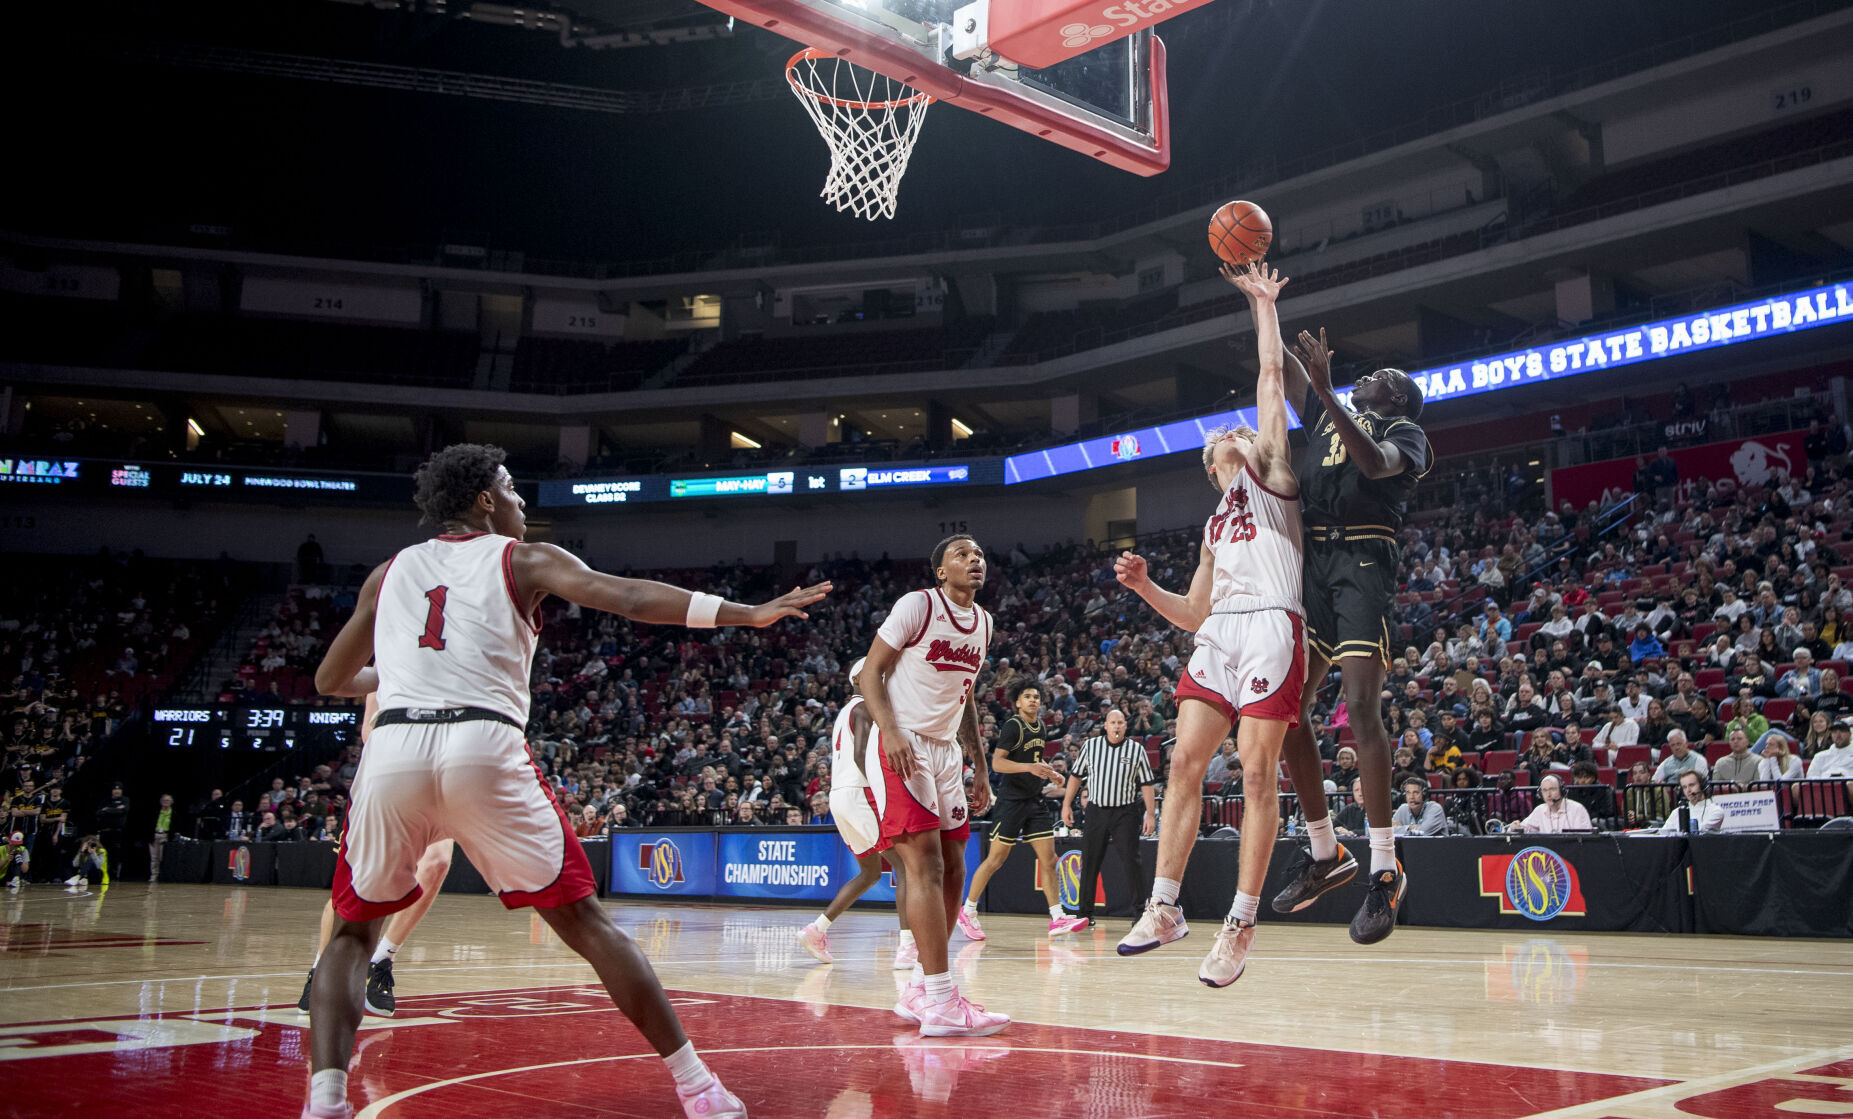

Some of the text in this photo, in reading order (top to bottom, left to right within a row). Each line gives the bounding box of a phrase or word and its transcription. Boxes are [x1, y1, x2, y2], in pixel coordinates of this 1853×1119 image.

[1103, 0, 1188, 27] Sta
[1776, 87, 1811, 109] 219
[314, 297, 343, 310] 214
[568, 315, 597, 328] 215
[1415, 287, 1853, 399] SAA BOYS STATE BASKETBALL
[16, 459, 79, 478] MRAZ
[112, 469, 150, 480] SPECIAL
[112, 478, 149, 488] GUESTS
[181, 472, 231, 486] JULY 24
[244, 477, 293, 488] PINEWOOD
[294, 479, 320, 489] BOWL
[778, 477, 786, 489] 5
[808, 475, 826, 489] 1st
[848, 474, 856, 486] 2
[867, 469, 932, 485] ELM CREEK
[611, 481, 641, 492] SCORE
[715, 479, 766, 493] MAY-HAY
[585, 493, 613, 503] CLASS
[937, 521, 968, 534] 115
[1230, 511, 1257, 543] 25
[418, 585, 449, 651] 1
[154, 710, 211, 722] WARRIORS
[246, 709, 285, 728] 3:39
[169, 728, 195, 746] 21
[253, 737, 262, 749] 2
[1719, 800, 1750, 810] INCOLN
[1730, 808, 1762, 817] SPORTS
[758, 840, 796, 861] STATE
[724, 864, 829, 887] CHAMPIONSHIPS
